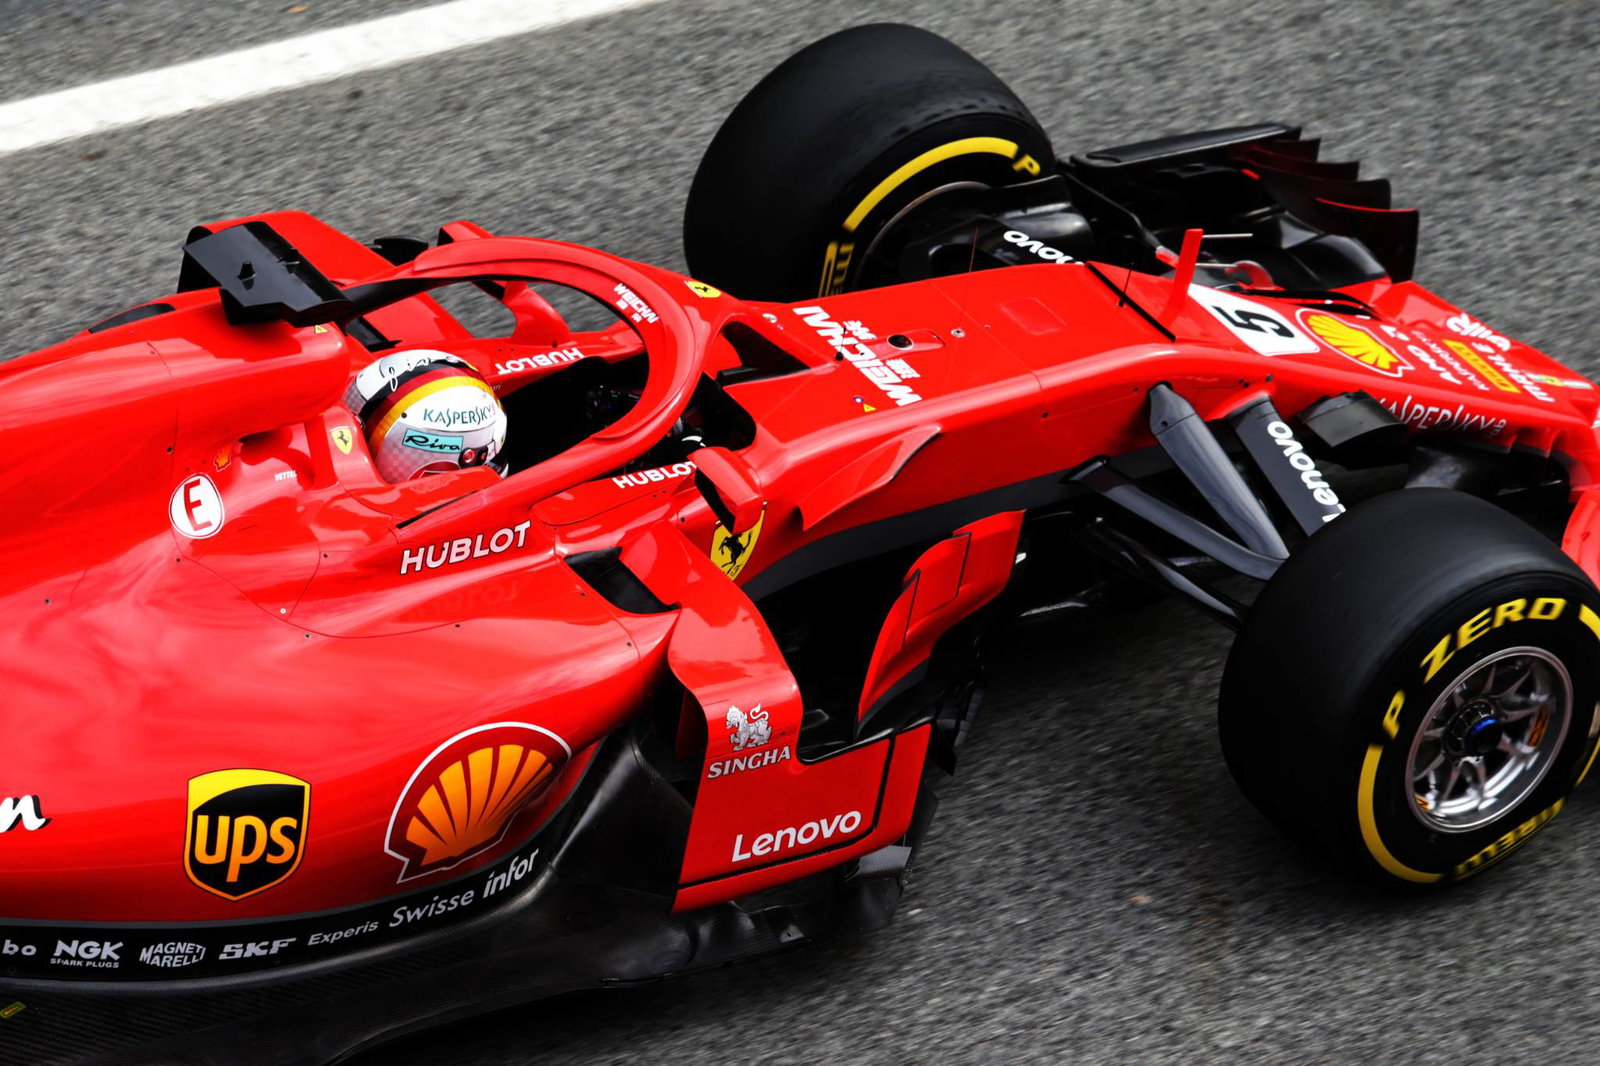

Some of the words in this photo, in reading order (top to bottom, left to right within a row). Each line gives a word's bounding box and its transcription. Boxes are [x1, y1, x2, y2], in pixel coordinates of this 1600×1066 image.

[1012, 154, 1041, 177] P
[613, 283, 660, 324] WEICHAI
[1213, 305, 1295, 338] 5
[497, 347, 585, 376] HUBLOT
[792, 306, 923, 406] WEICHAI
[1407, 345, 1462, 385] AMD
[404, 435, 462, 452] Riva
[183, 479, 213, 532] E
[400, 521, 531, 575] HUBLOT
[1382, 689, 1405, 740] P
[1419, 597, 1567, 684] ZERO
[707, 746, 791, 779] SINGHA
[194, 815, 297, 882] ups
[731, 810, 862, 862] Lenovo
[483, 849, 539, 898] infor
[389, 889, 475, 928] Swisse
[53, 939, 124, 961] NGK
[219, 937, 297, 960] SKF
[307, 920, 379, 946] Experis
[85, 961, 120, 969] PLUGS
